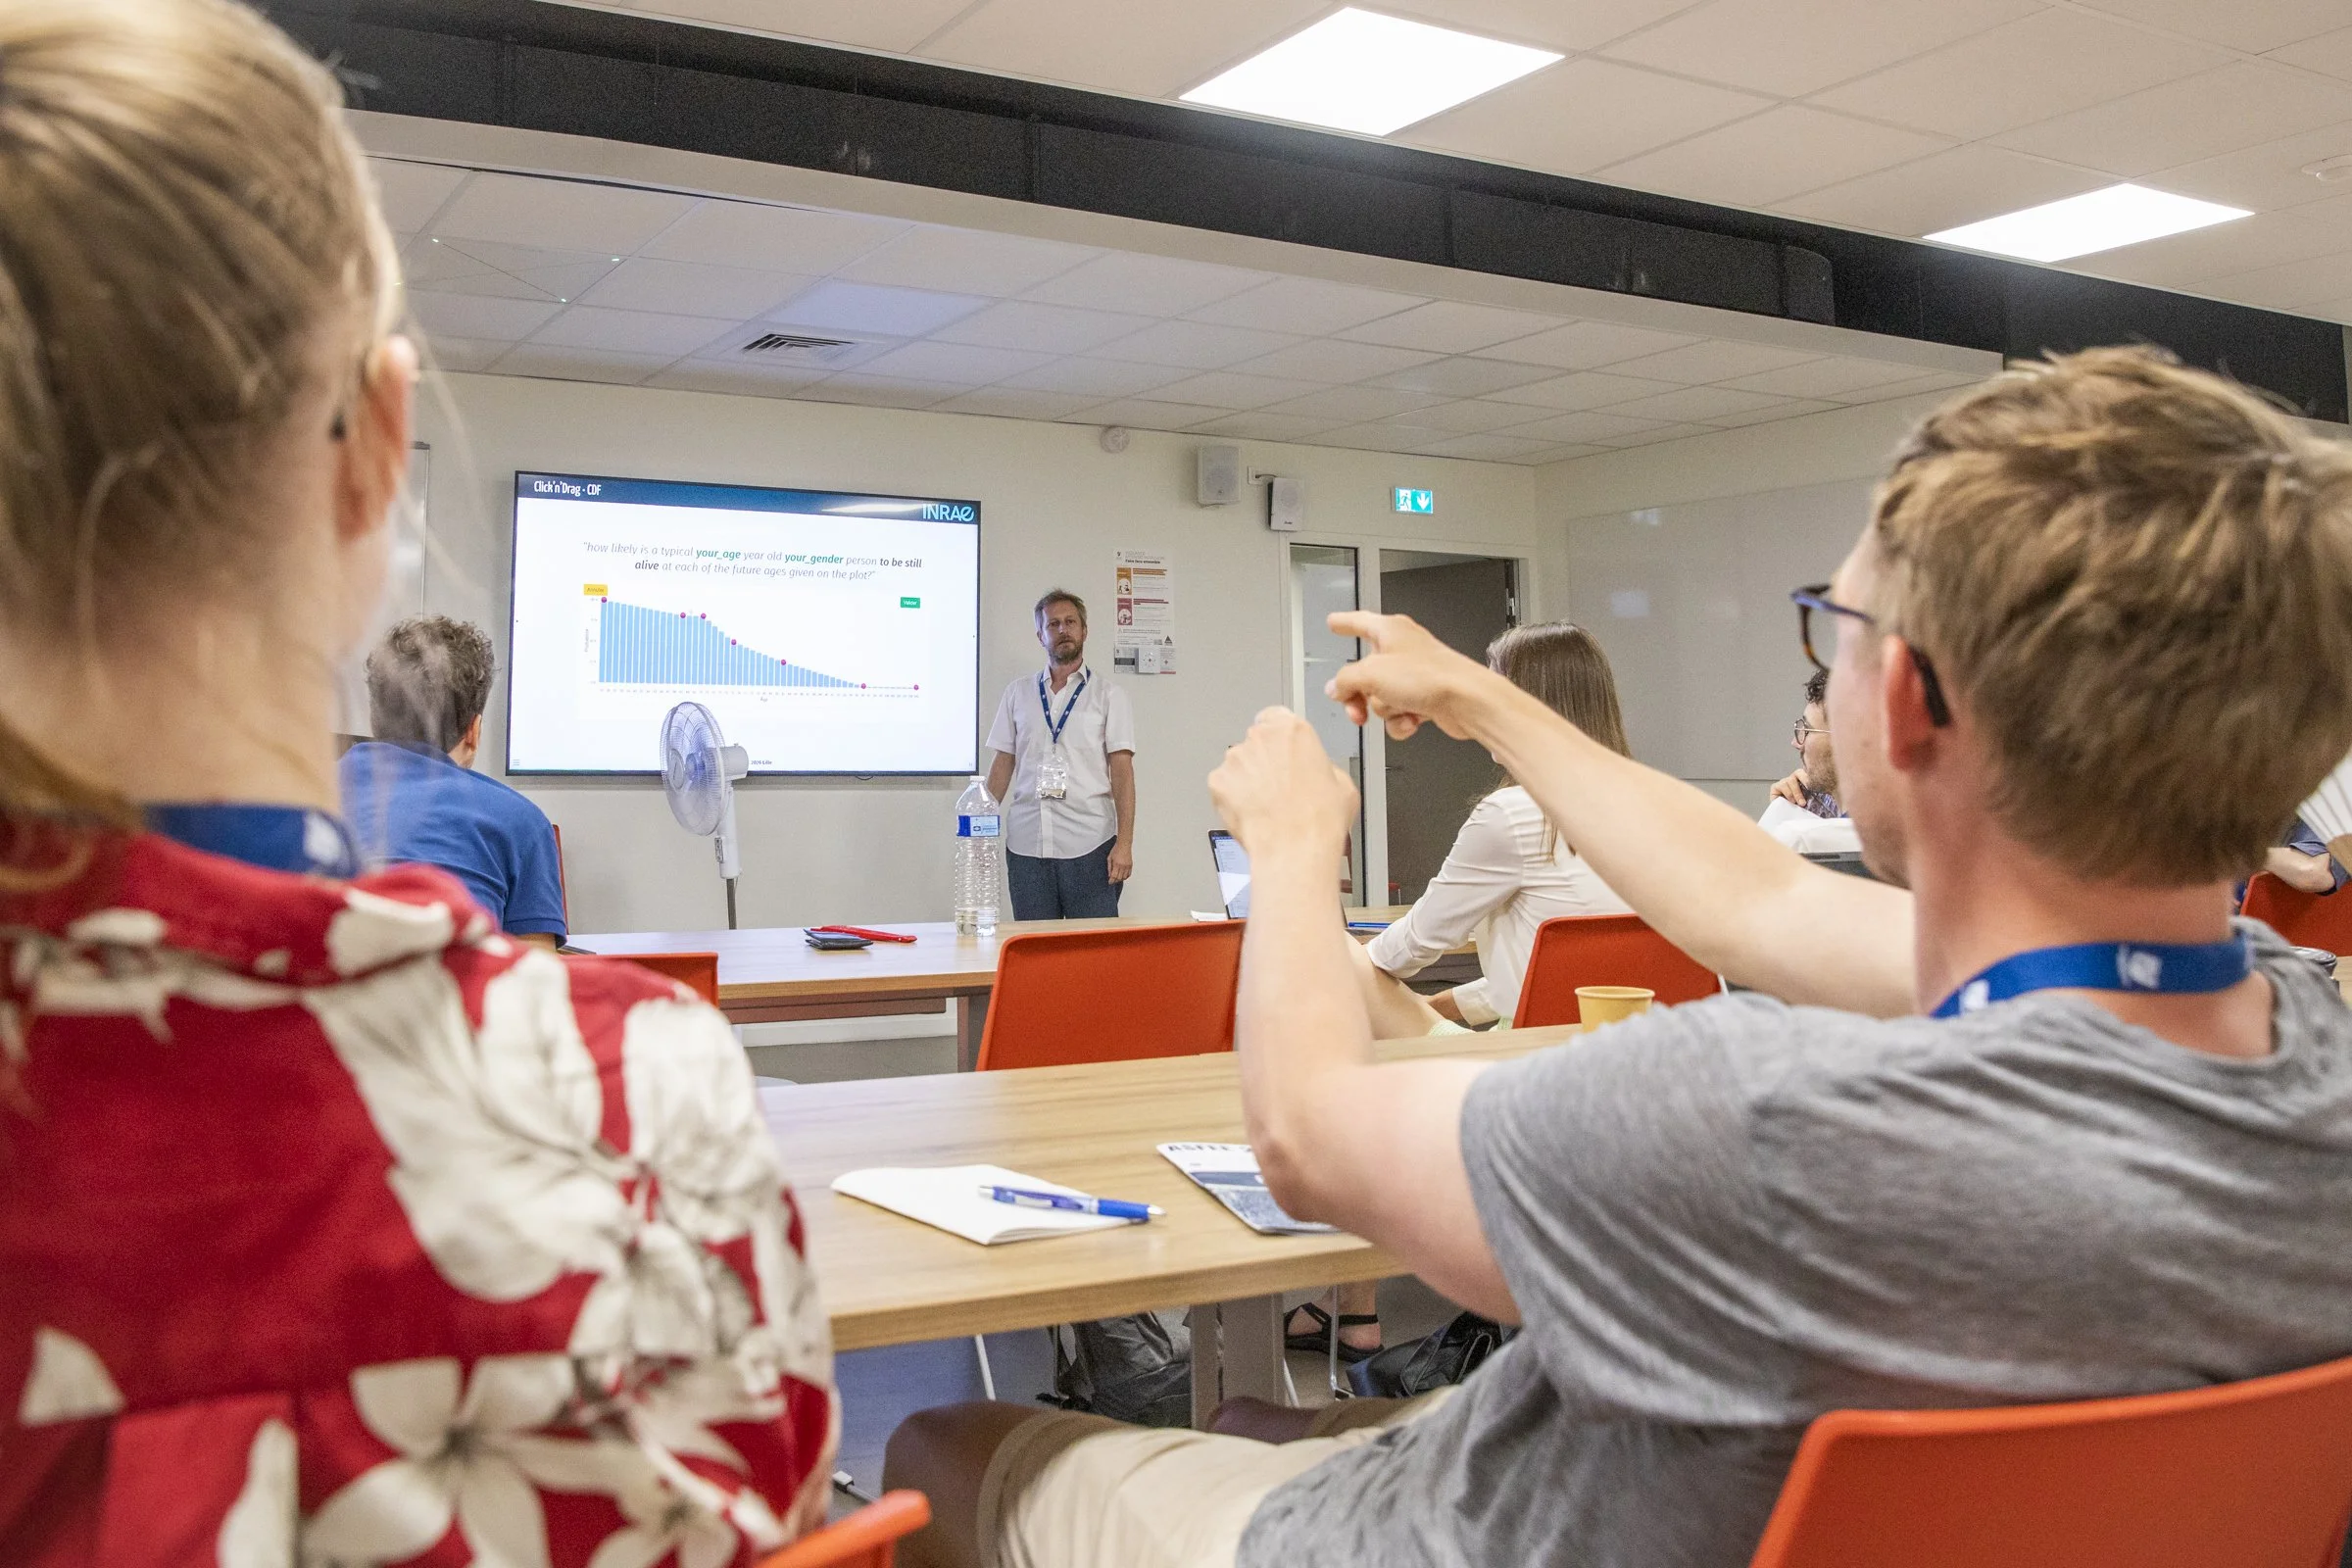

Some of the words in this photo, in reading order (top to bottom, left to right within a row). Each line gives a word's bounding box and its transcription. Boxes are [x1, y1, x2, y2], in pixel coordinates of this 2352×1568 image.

[587, 484, 602, 496] CDF
[611, 542, 638, 556] likely
[640, 544, 649, 555] is
[651, 547, 659, 556] a
[661, 546, 694, 558] typical
[695, 549, 742, 562] your_age
[743, 551, 765, 563] year
[766, 551, 782, 562] old
[784, 552, 844, 566] your_gender
[845, 557, 877, 567] person
[879, 557, 890, 566] to
[891, 557, 904, 567] be
[905, 558, 923, 568] still
[634, 560, 660, 570] alive
[662, 563, 672, 571] at
[674, 562, 699, 572] each
[701, 562, 712, 574] of
[713, 564, 730, 574] the
[731, 564, 761, 576] future
[763, 567, 787, 578] ages
[789, 568, 814, 580] given
[832, 569, 846, 579] the
